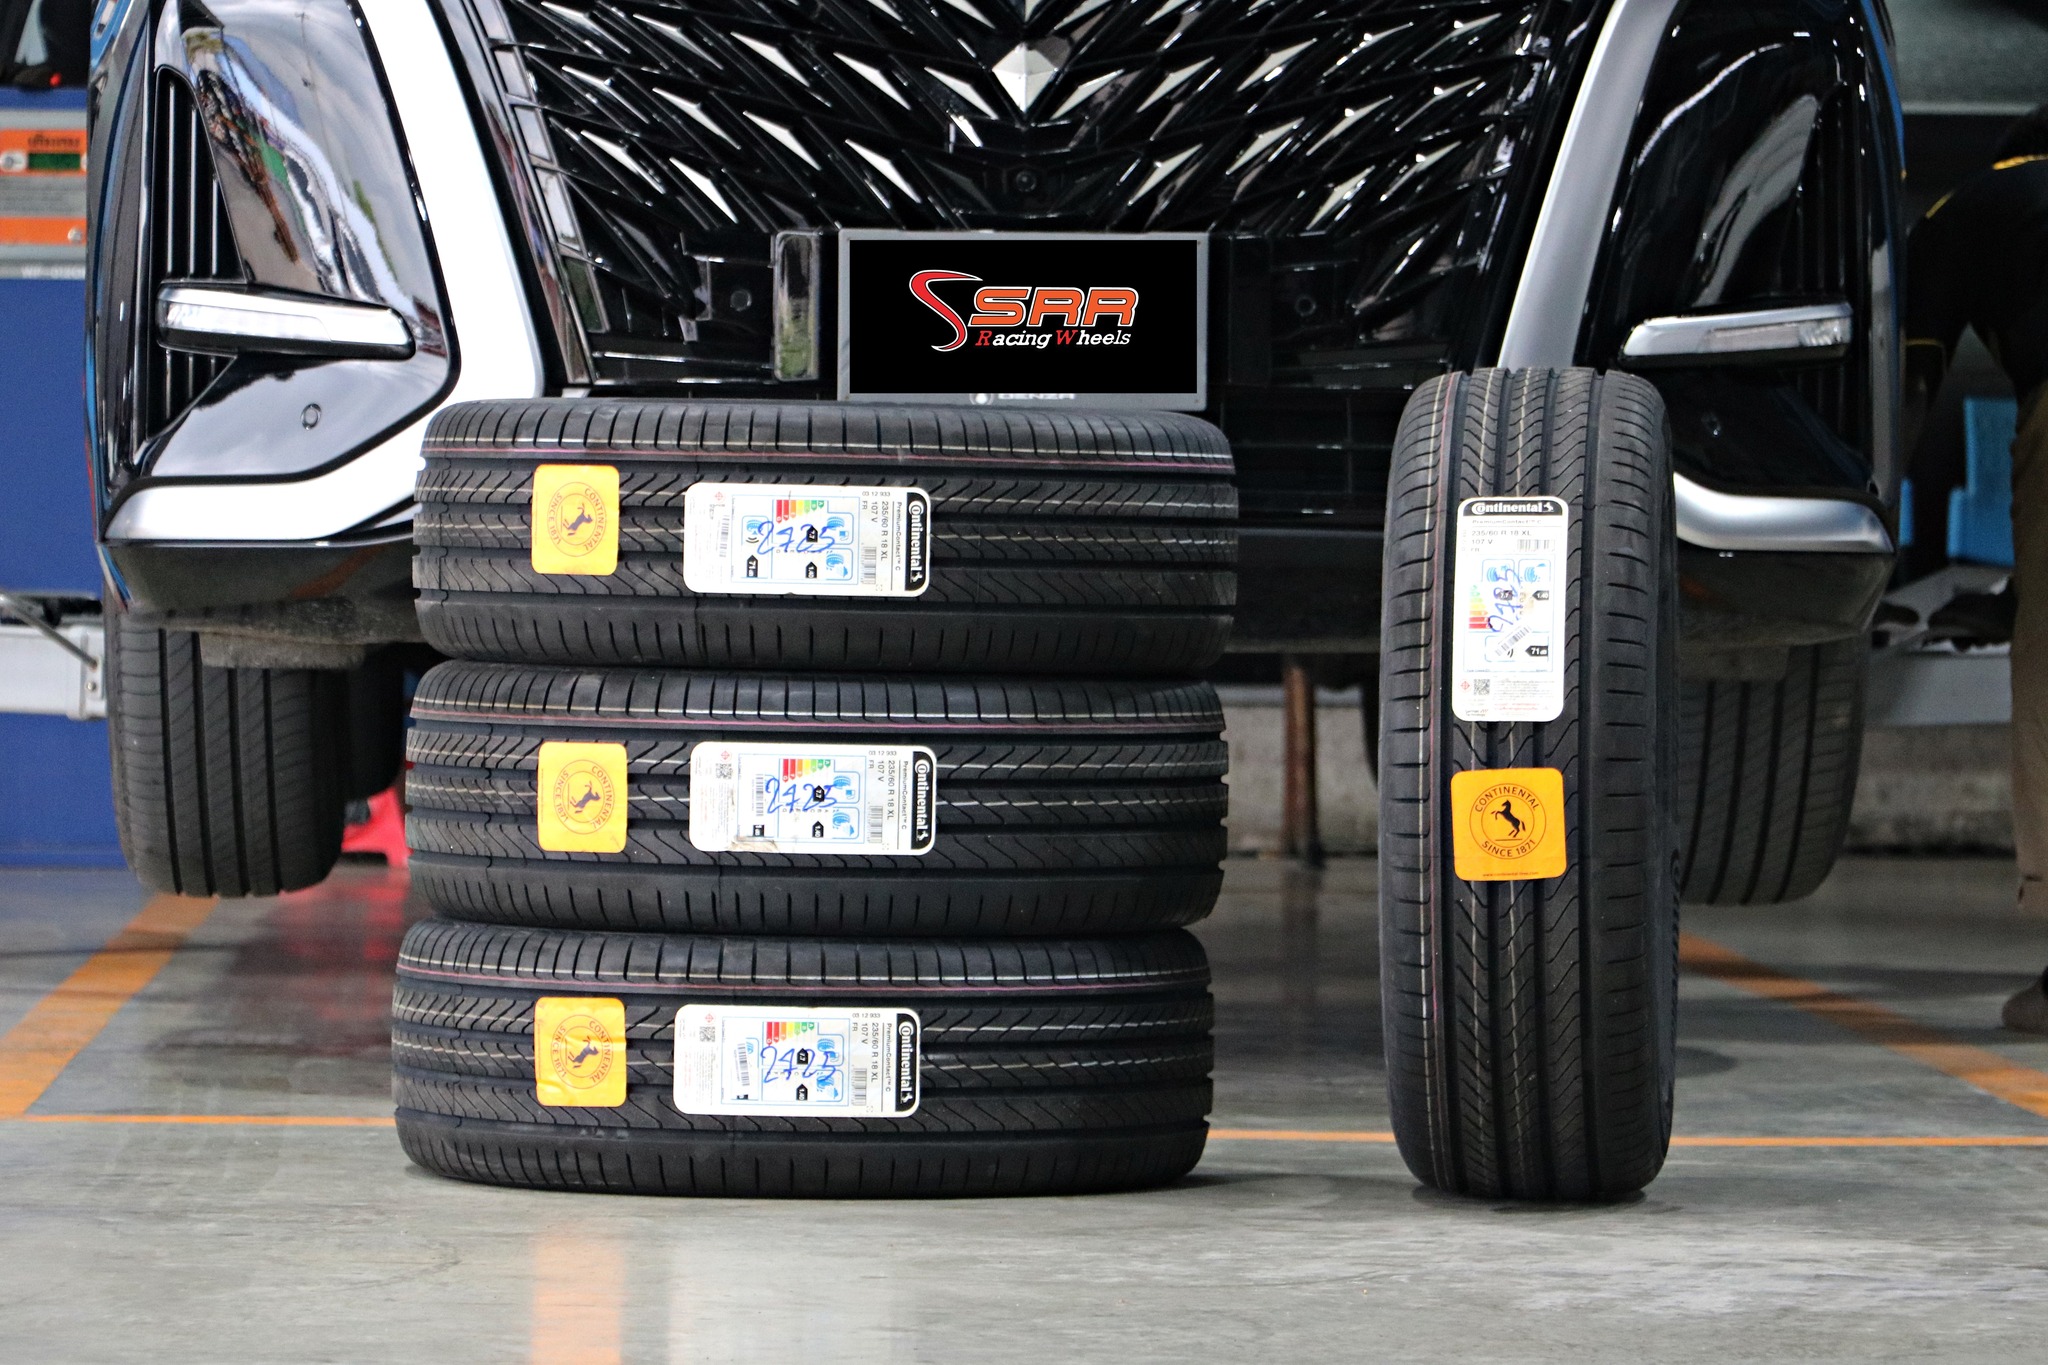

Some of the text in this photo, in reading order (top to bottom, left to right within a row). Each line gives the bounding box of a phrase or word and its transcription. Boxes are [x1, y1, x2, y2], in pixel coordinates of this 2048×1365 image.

[549, 492, 563, 520] SINCE
[862, 501, 868, 510] FR
[881, 501, 889, 528] 235/60
[1471, 502, 1543, 515] Continental
[583, 488, 604, 551] CONTINENTAL
[881, 540, 888, 548] 18
[909, 501, 924, 571] Continental
[881, 551, 888, 561] XL
[555, 771, 569, 798] SINCE
[590, 765, 612, 829] CONTINENTAL
[915, 760, 930, 830] Continental
[888, 798, 894, 807] 18
[1475, 786, 1539, 813] CONTINENTAL
[887, 810, 894, 820] XL
[1482, 839, 1536, 857] SINCE 1871
[552, 1026, 566, 1054] SINCE
[852, 1022, 858, 1032] FR
[589, 1021, 611, 1083] CONTINENTAL
[871, 1061, 878, 1070] 18
[899, 1021, 914, 1092] Continental
[871, 1072, 878, 1082] XL
